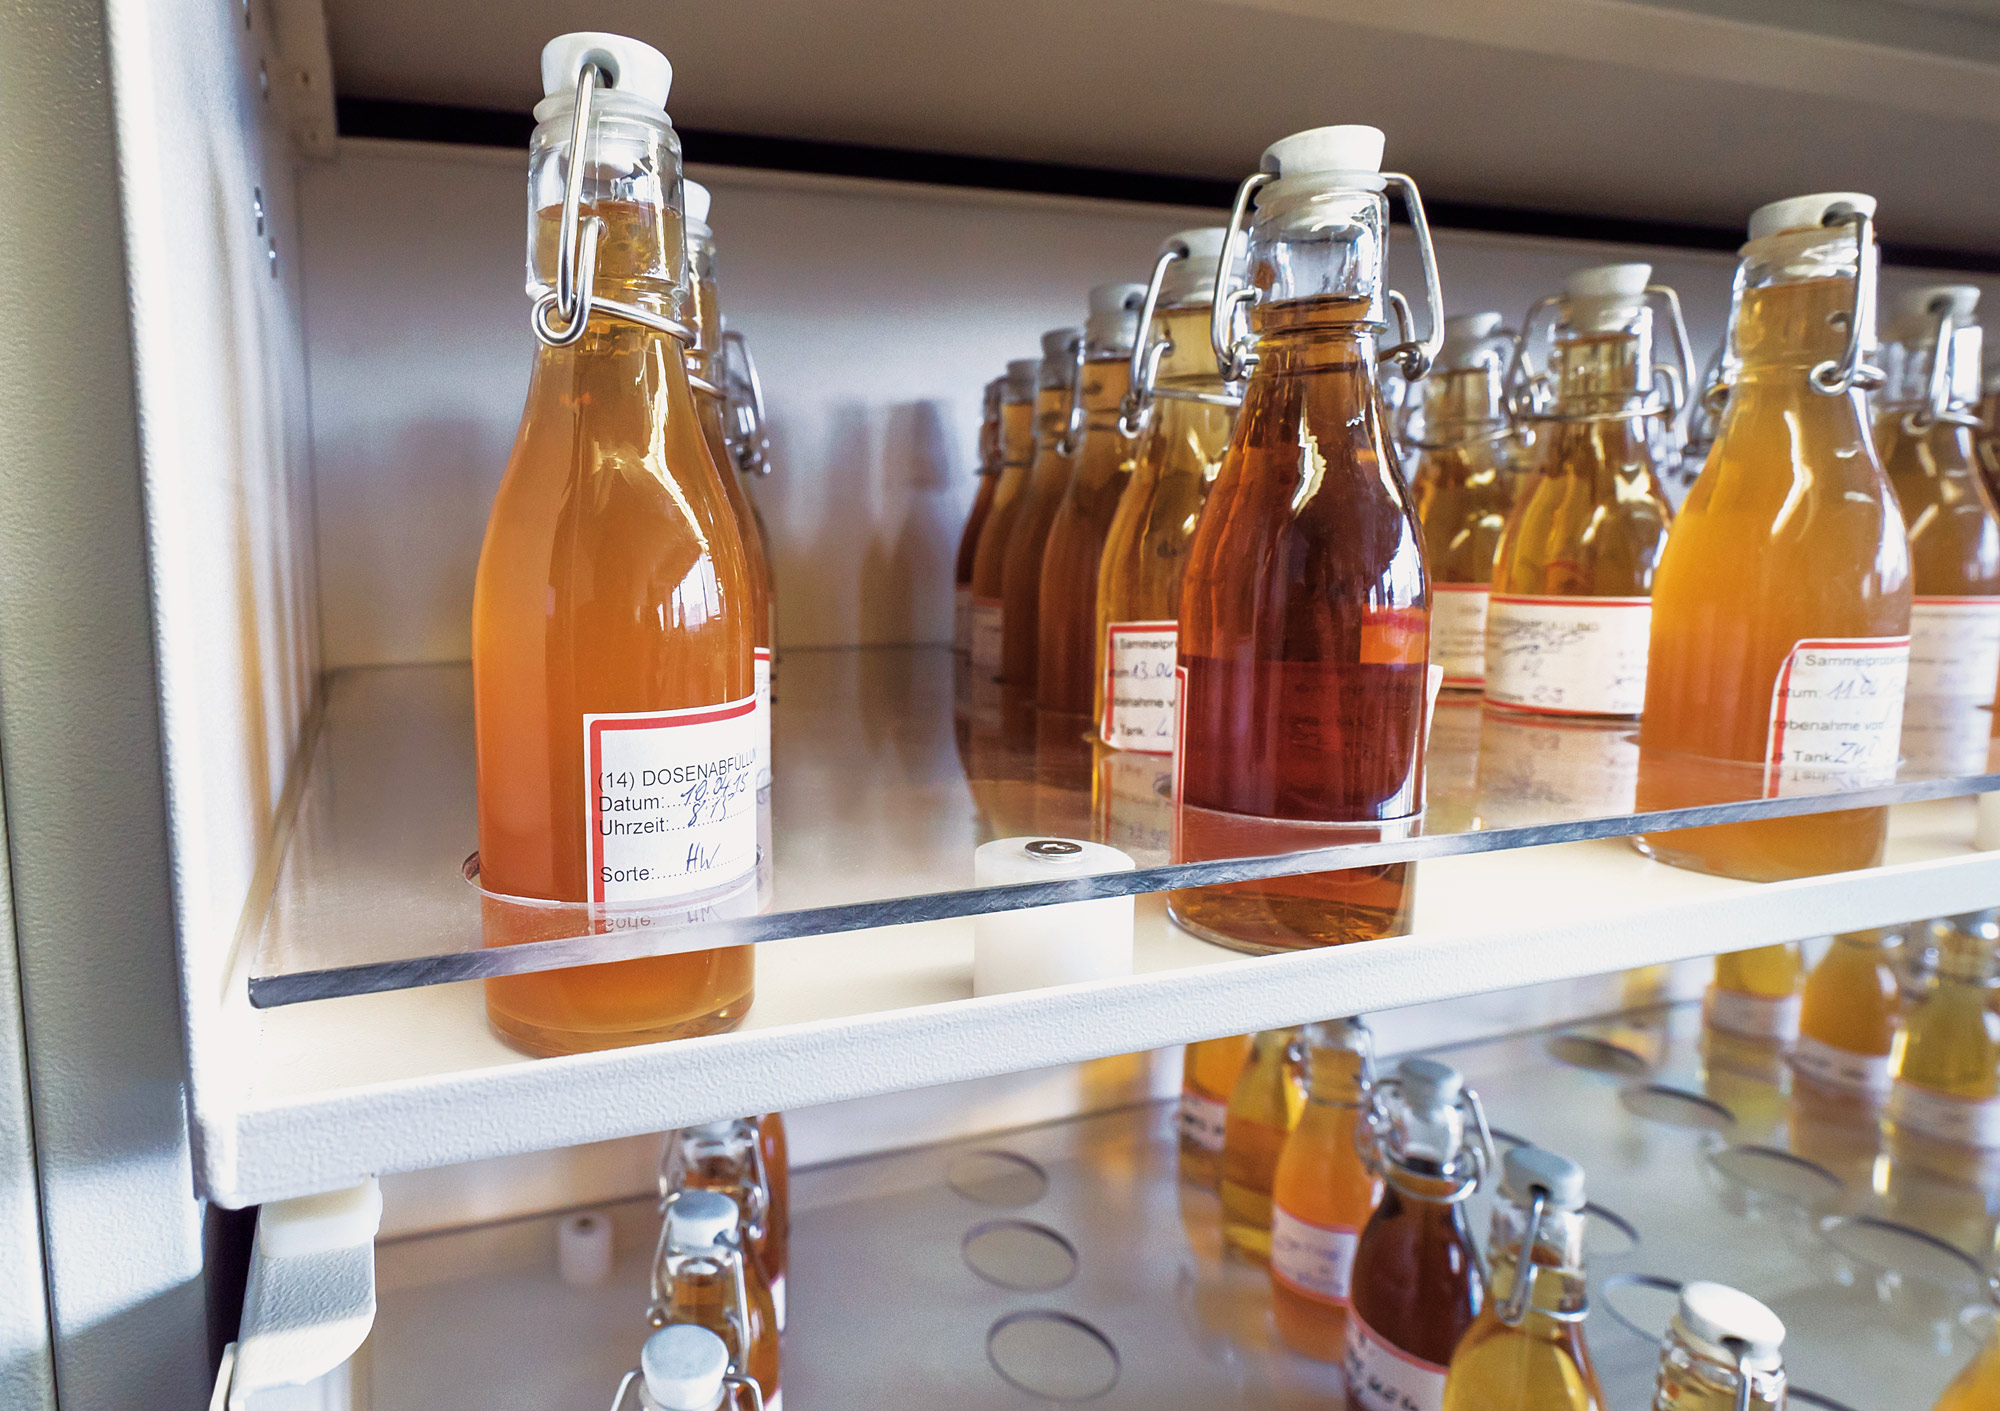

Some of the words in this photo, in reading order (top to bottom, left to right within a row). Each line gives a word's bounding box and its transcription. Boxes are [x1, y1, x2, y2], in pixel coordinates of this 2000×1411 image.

[598, 771, 635, 792] (14)
[599, 796, 665, 812] Datum:
[599, 816, 670, 836] Uhrzeit:
[600, 866, 655, 883] Sorte:
